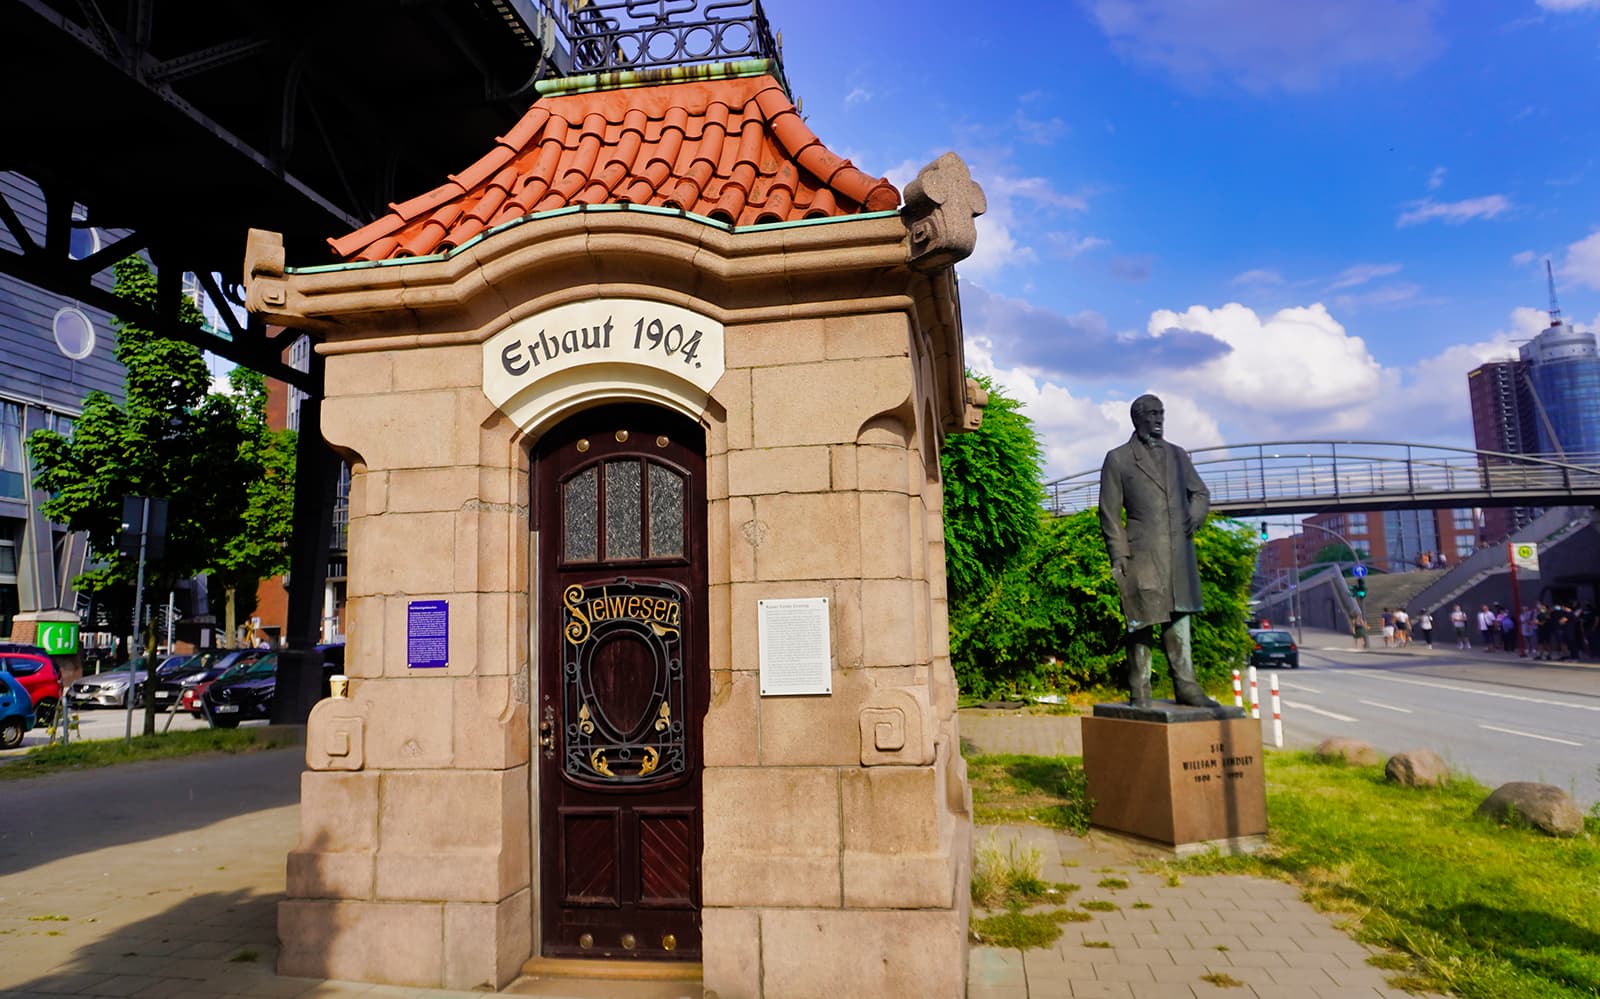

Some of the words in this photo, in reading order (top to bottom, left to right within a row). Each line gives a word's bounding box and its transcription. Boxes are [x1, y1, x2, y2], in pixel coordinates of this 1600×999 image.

[501, 315, 614, 376] Erbaut
[633, 316, 704, 369] 1904.
[563, 584, 680, 645] Sielwesen
[1182, 759, 1217, 770] WILLIAM
[1210, 743, 1224, 753] SIR
